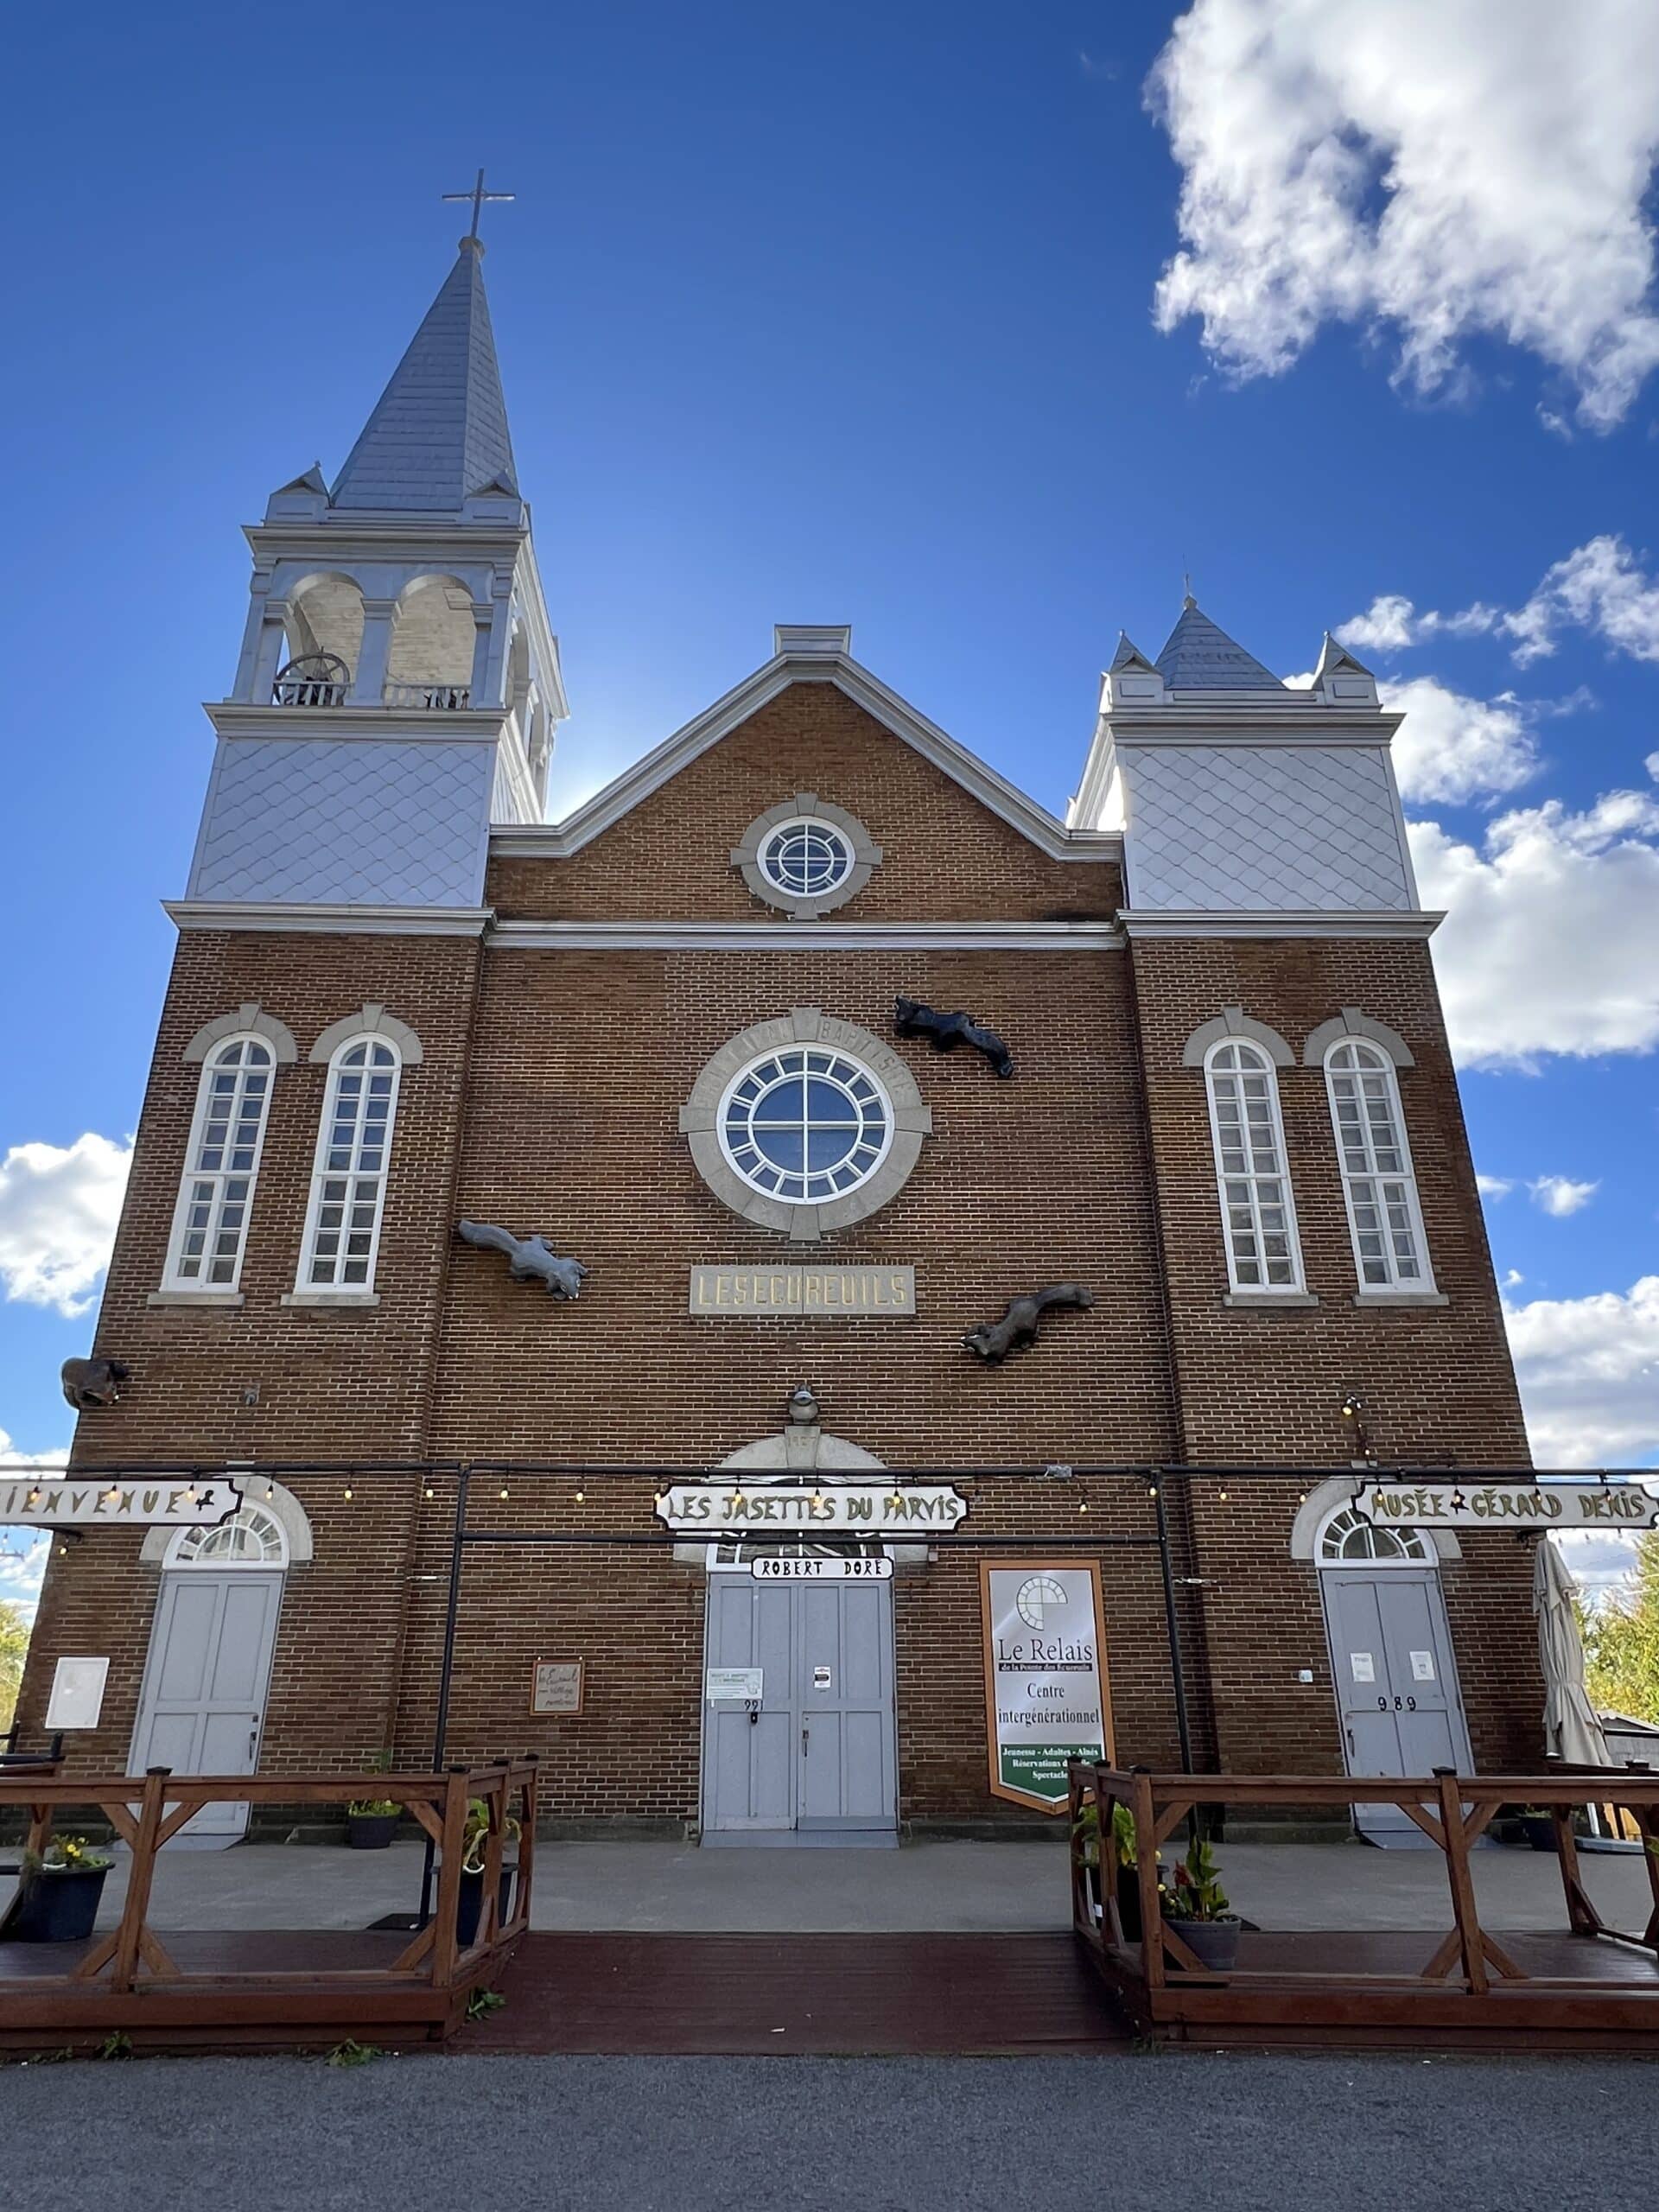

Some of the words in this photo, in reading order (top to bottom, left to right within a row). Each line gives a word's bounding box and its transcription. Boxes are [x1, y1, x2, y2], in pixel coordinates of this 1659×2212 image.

[0, 1485, 185, 1514] IENVENUE
[667, 1495, 712, 1520] LES
[722, 1495, 836, 1521] JASETTES
[847, 1497, 873, 1521] DU
[883, 1494, 959, 1521] PARVIS
[1371, 1488, 1448, 1519] MUSÉE
[1471, 1487, 1563, 1518] GÉRARD
[1578, 1491, 1646, 1518] DENIS
[761, 1560, 823, 1576] ROBERT
[843, 1557, 883, 1576] DORÉ
[997, 1637, 1024, 1661] Le
[1030, 1637, 1093, 1661] Relais
[1027, 1682, 1065, 1699] Centre
[744, 1699, 764, 1711] 991
[1377, 1696, 1417, 1712] 989
[998, 1707, 1100, 1727] intergénérationnel
